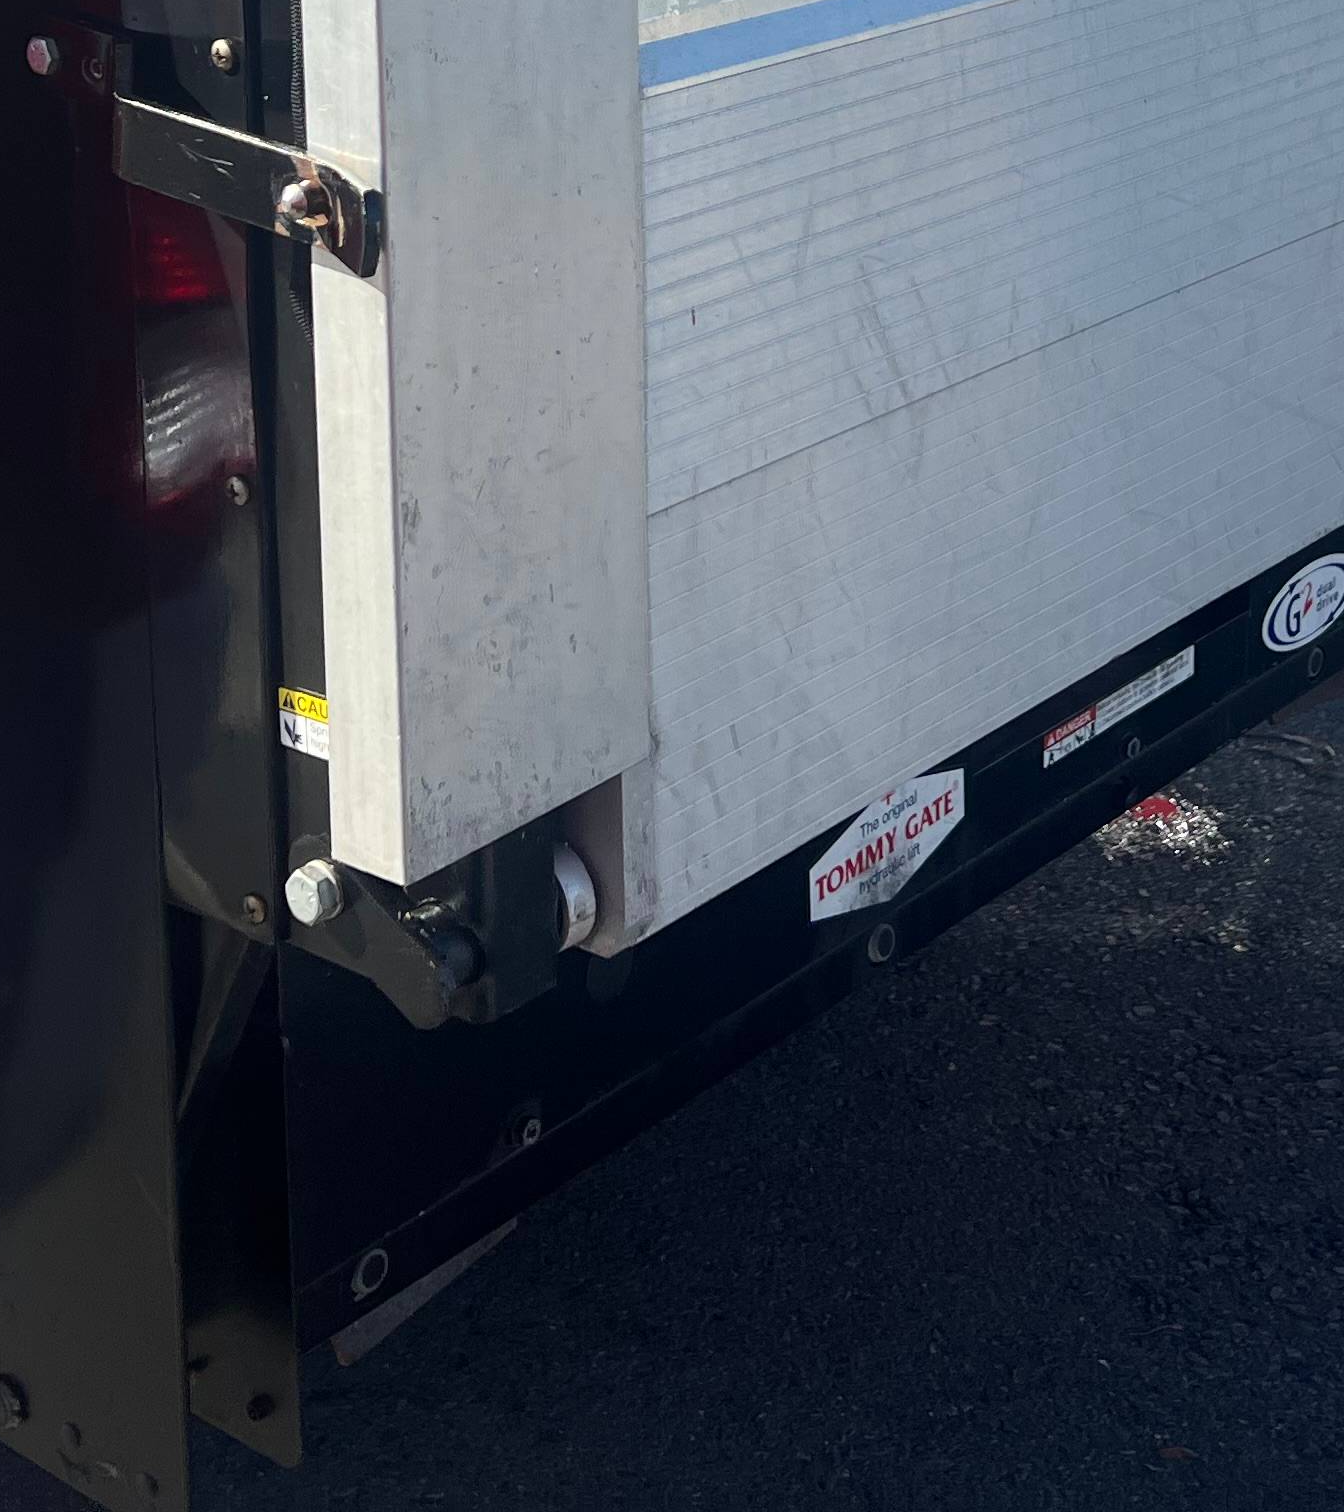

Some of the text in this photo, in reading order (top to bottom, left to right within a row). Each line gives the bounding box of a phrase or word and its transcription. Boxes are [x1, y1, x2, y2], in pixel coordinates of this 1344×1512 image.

[1317, 576, 1336, 598] dual
[1317, 591, 1338, 612] drive
[860, 789, 918, 838] The original
[816, 790, 954, 902] TOMMY GATE
